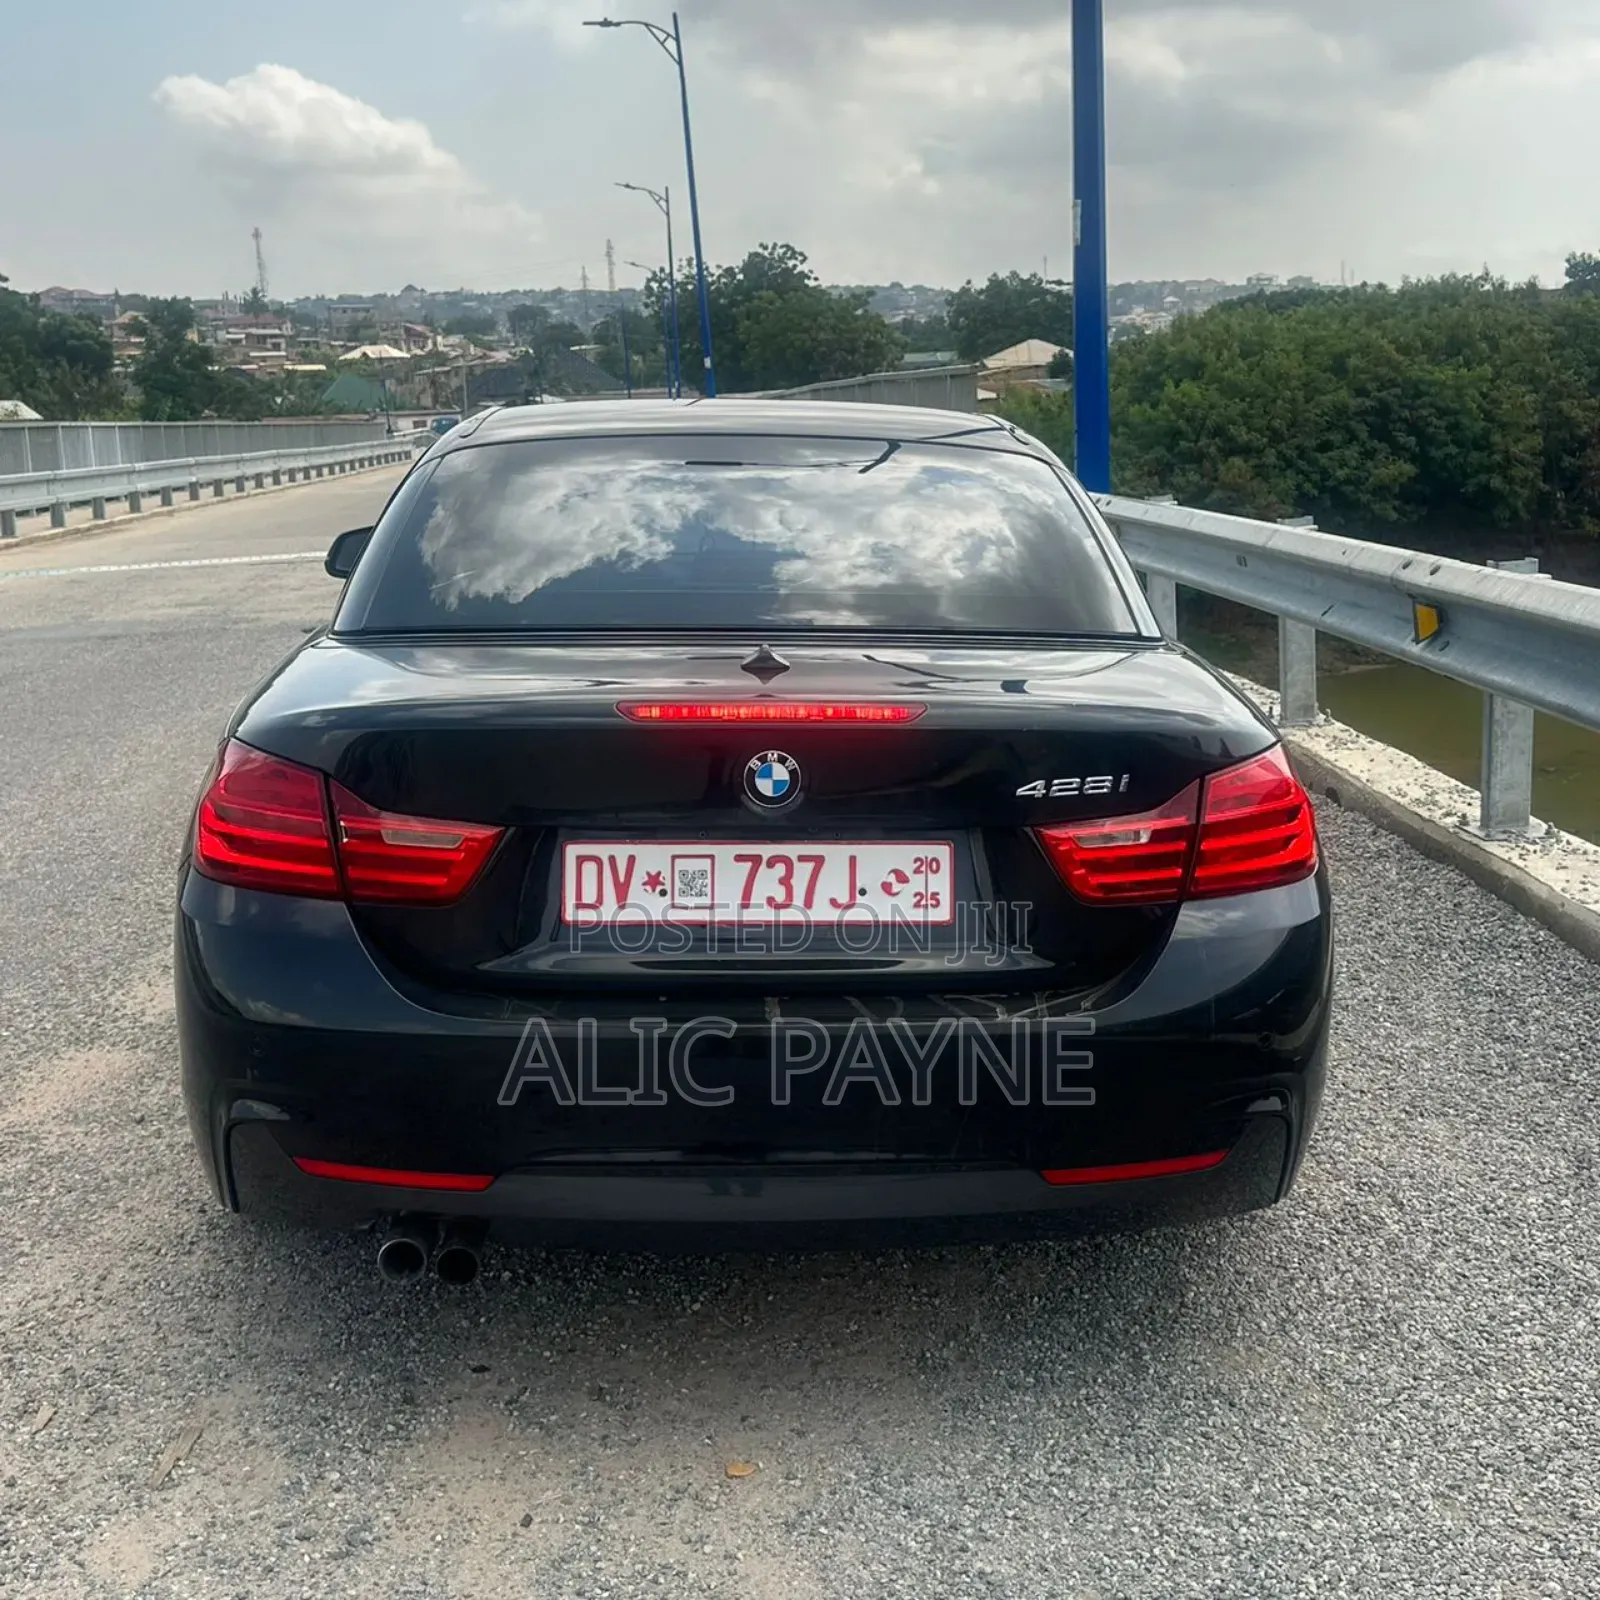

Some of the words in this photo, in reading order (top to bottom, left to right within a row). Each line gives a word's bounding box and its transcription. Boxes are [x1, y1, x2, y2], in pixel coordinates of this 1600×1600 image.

[749, 752, 797, 772] BMW
[1015, 773, 1130, 798] 428i
[575, 854, 637, 910] DV
